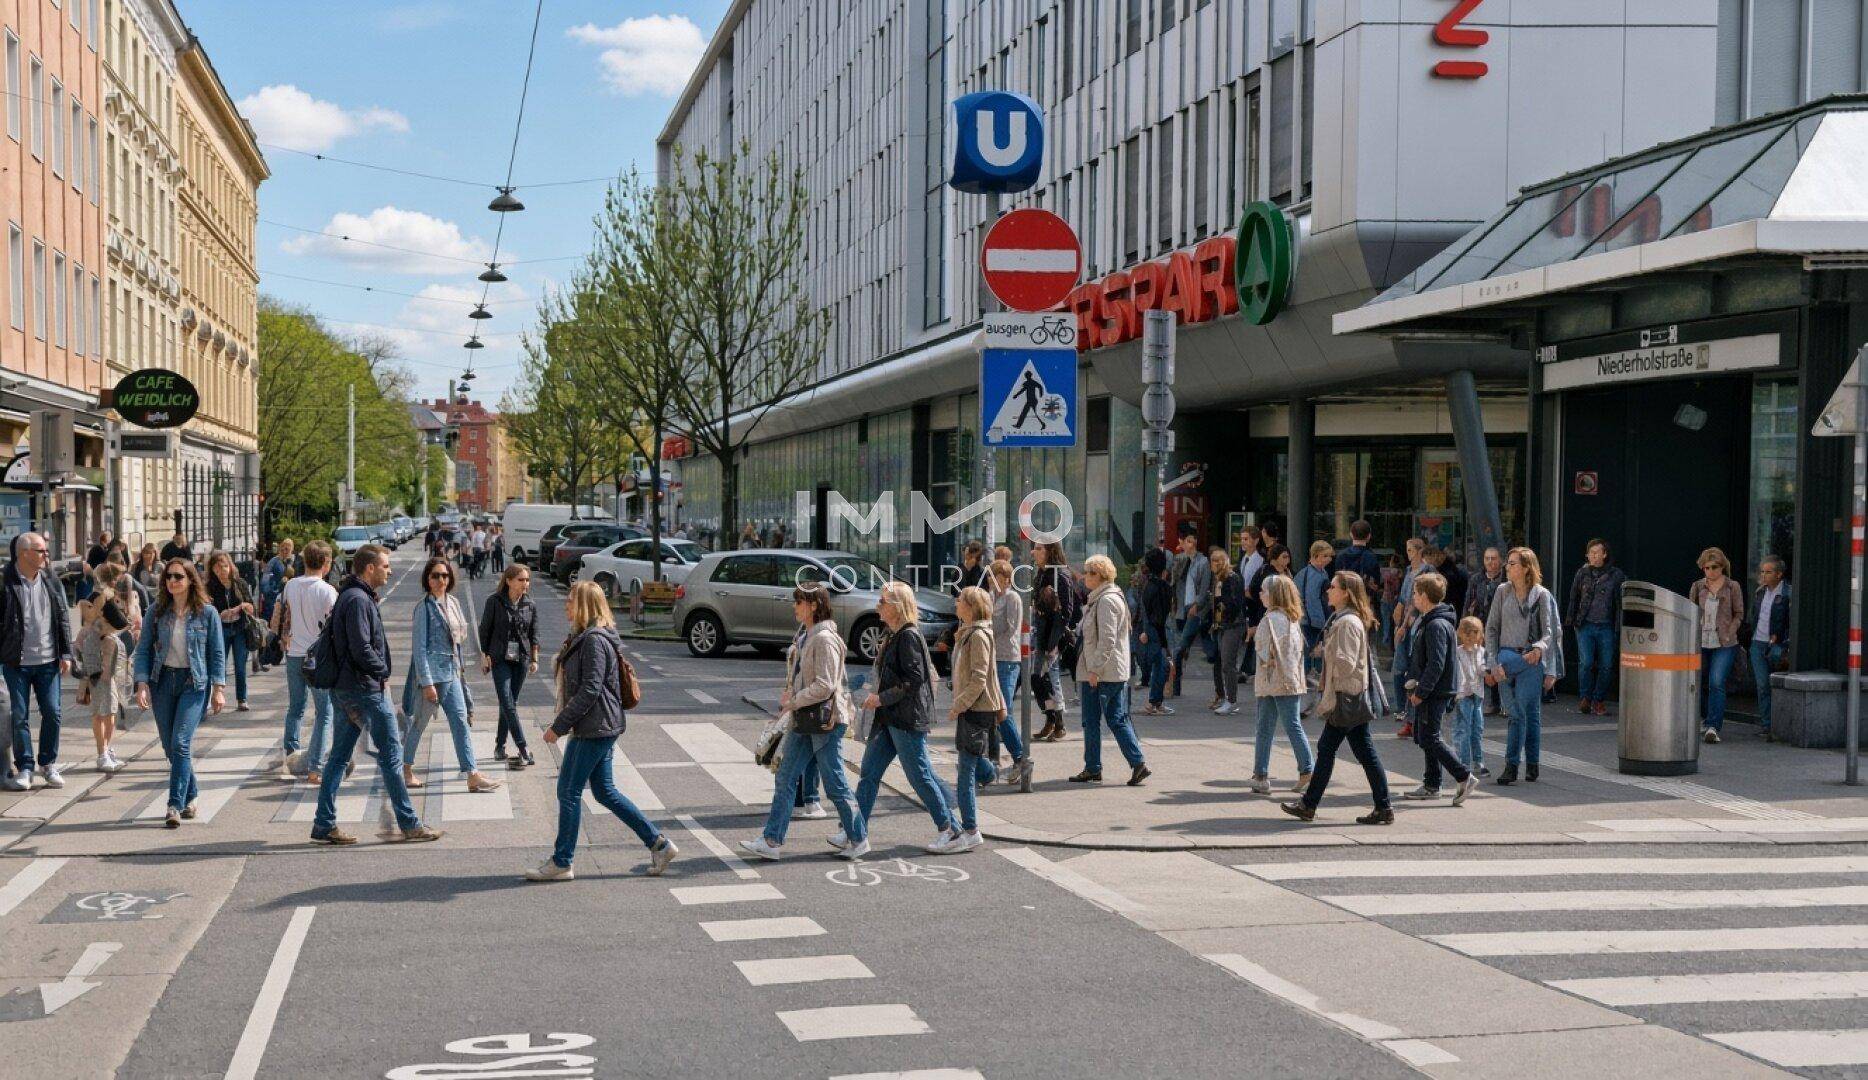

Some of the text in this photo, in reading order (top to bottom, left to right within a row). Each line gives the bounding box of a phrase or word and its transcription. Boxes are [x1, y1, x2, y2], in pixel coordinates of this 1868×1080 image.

[977, 110, 1027, 166] U
[985, 322, 1026, 338] ausgen
[136, 376, 175, 389] CAFE
[119, 393, 192, 406] WEIDLICH
